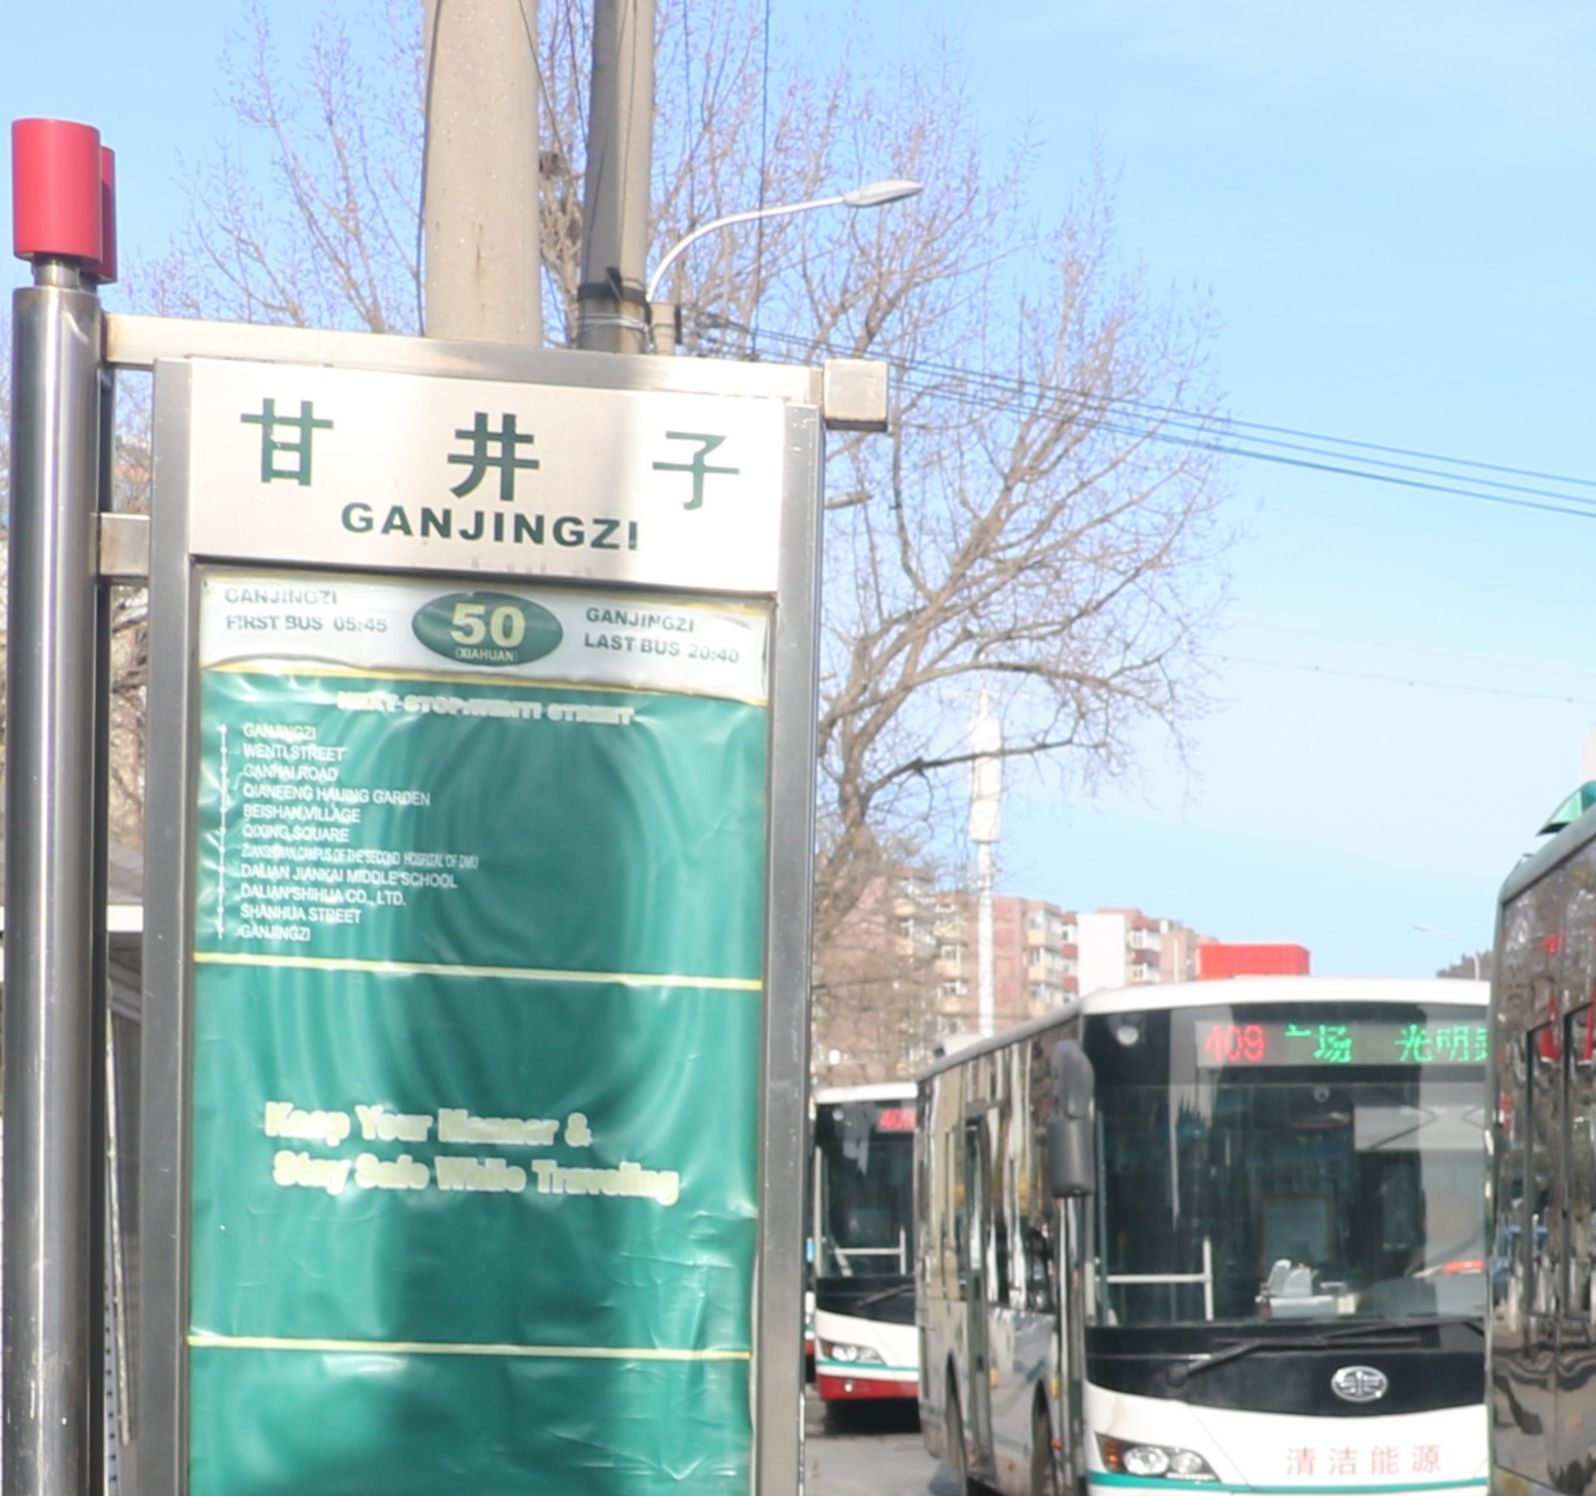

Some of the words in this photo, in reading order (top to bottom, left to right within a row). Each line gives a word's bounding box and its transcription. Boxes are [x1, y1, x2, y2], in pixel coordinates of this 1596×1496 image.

[240, 397, 740, 510] 甘井子
[341, 502, 639, 551] GANJINGZI
[225, 587, 337, 604] GANJINGZI
[226, 615, 279, 630] FIRST
[285, 616, 323, 630] BUS
[333, 618, 387, 633] 05:45
[451, 603, 525, 647] 50
[586, 607, 695, 632] GANJINGZI
[584, 633, 636, 652] LAST
[640, 638, 680, 656] BUS
[688, 644, 739, 664] 20:40
[290, 746, 346, 762] STREET
[299, 767, 338, 782] ROAD
[372, 789, 431, 806] GARDEN
[304, 806, 361, 823] VILLAGE
[292, 826, 350, 842] SQUARE
[241, 863, 290, 879] DALIAN
[347, 869, 397, 885] MIDDLE
[401, 872, 457, 889] SCHOOL
[308, 907, 362, 924] STREET
[354, 1104, 433, 1142] Your
[564, 1112, 593, 1148] &
[1286, 1445, 1442, 1476] 清洁能源
